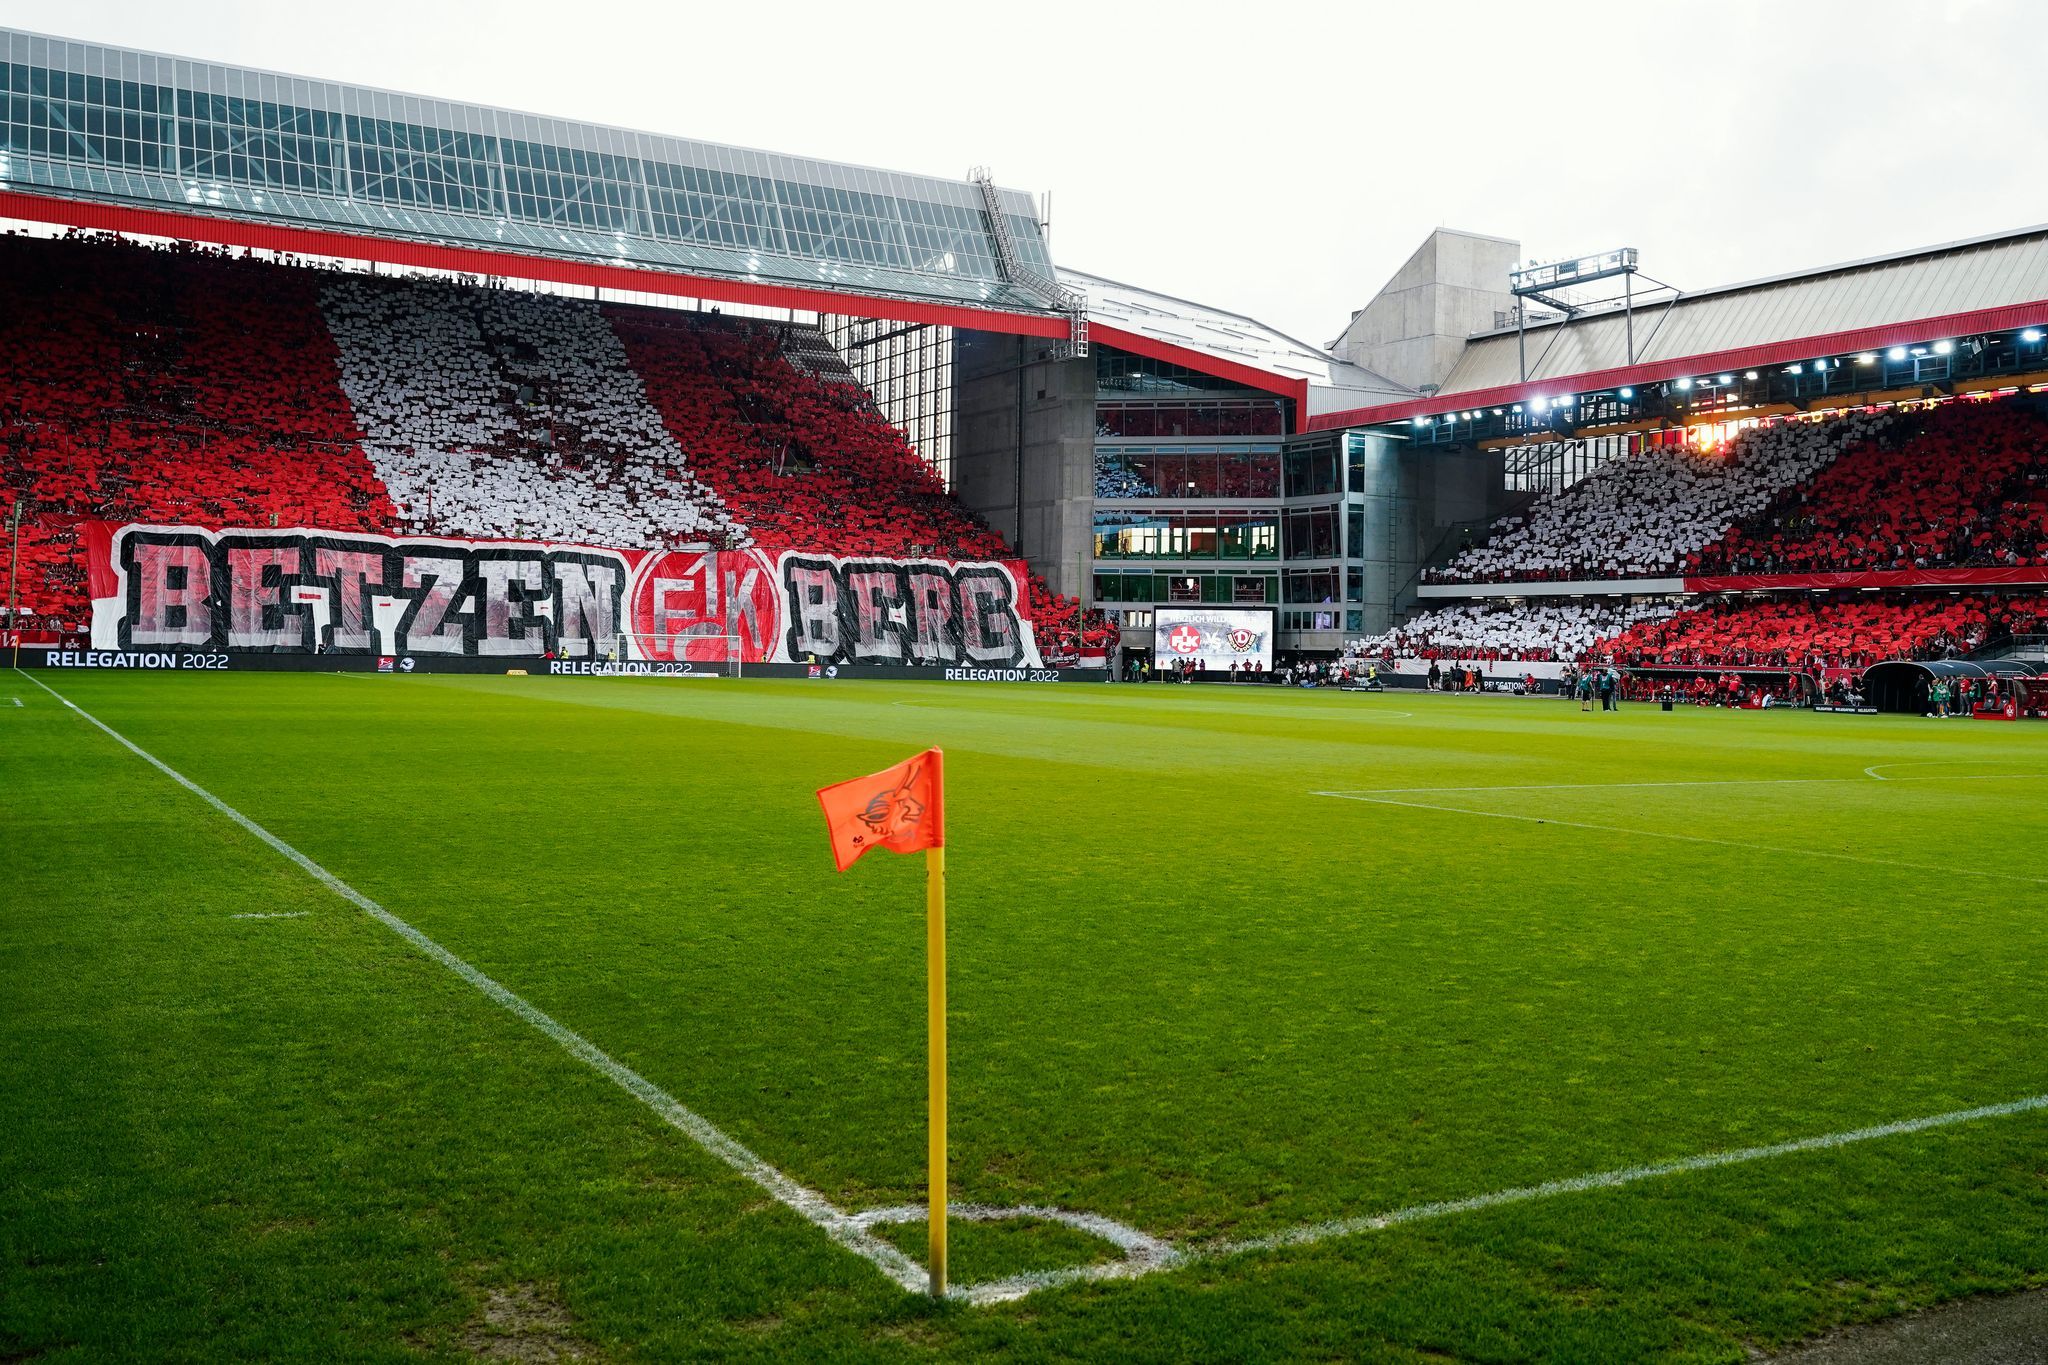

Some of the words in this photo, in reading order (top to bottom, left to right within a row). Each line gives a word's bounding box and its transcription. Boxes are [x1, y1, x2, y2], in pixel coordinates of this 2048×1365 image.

[119, 530, 627, 656] BETZEN
[783, 556, 1024, 667] BERG
[46, 651, 176, 668] RELEGATION
[182, 653, 229, 669] 2022
[550, 660, 652, 675] RELEGATION
[656, 662, 693, 674] 2022
[945, 667, 1027, 682] RELEGATION
[1029, 669, 1060, 682] 2022
